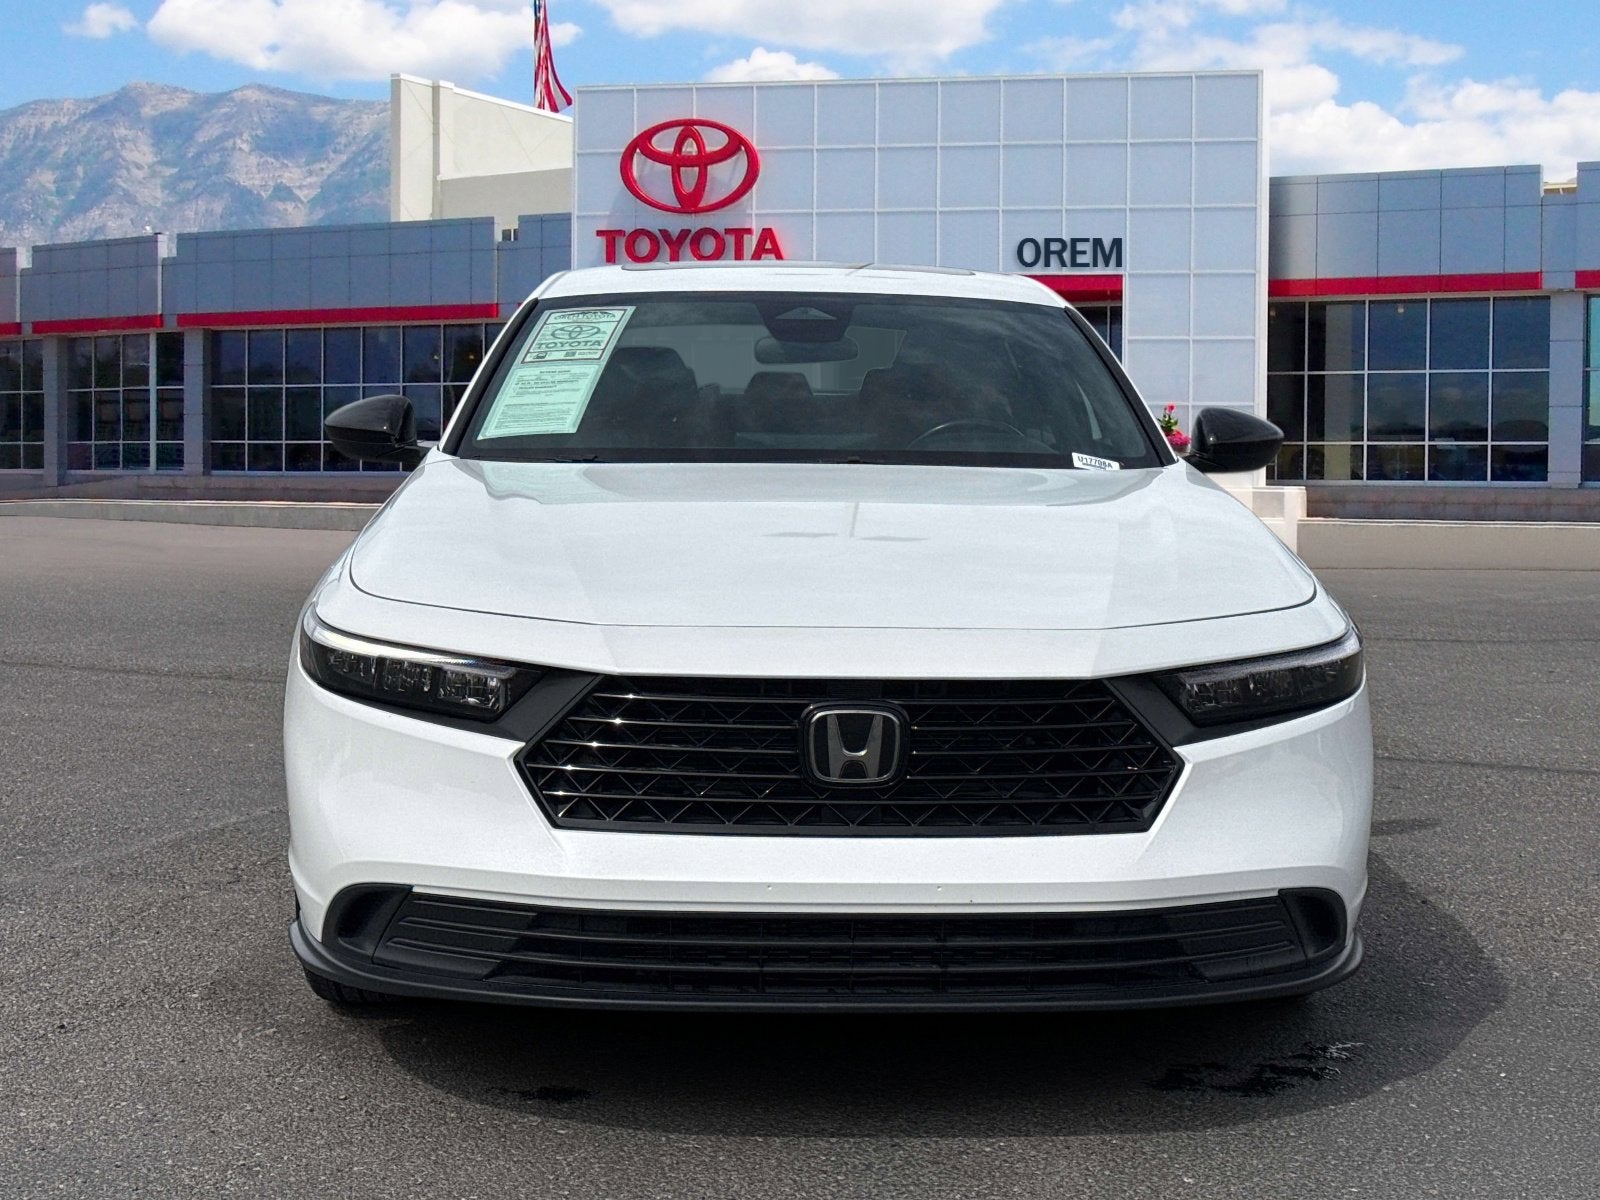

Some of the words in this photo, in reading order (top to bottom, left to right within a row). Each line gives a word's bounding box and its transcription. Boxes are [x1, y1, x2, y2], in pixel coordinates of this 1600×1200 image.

[596, 228, 784, 264] TOYOTA
[1017, 237, 1123, 268] OREM
[537, 340, 602, 349] TOYOTA
